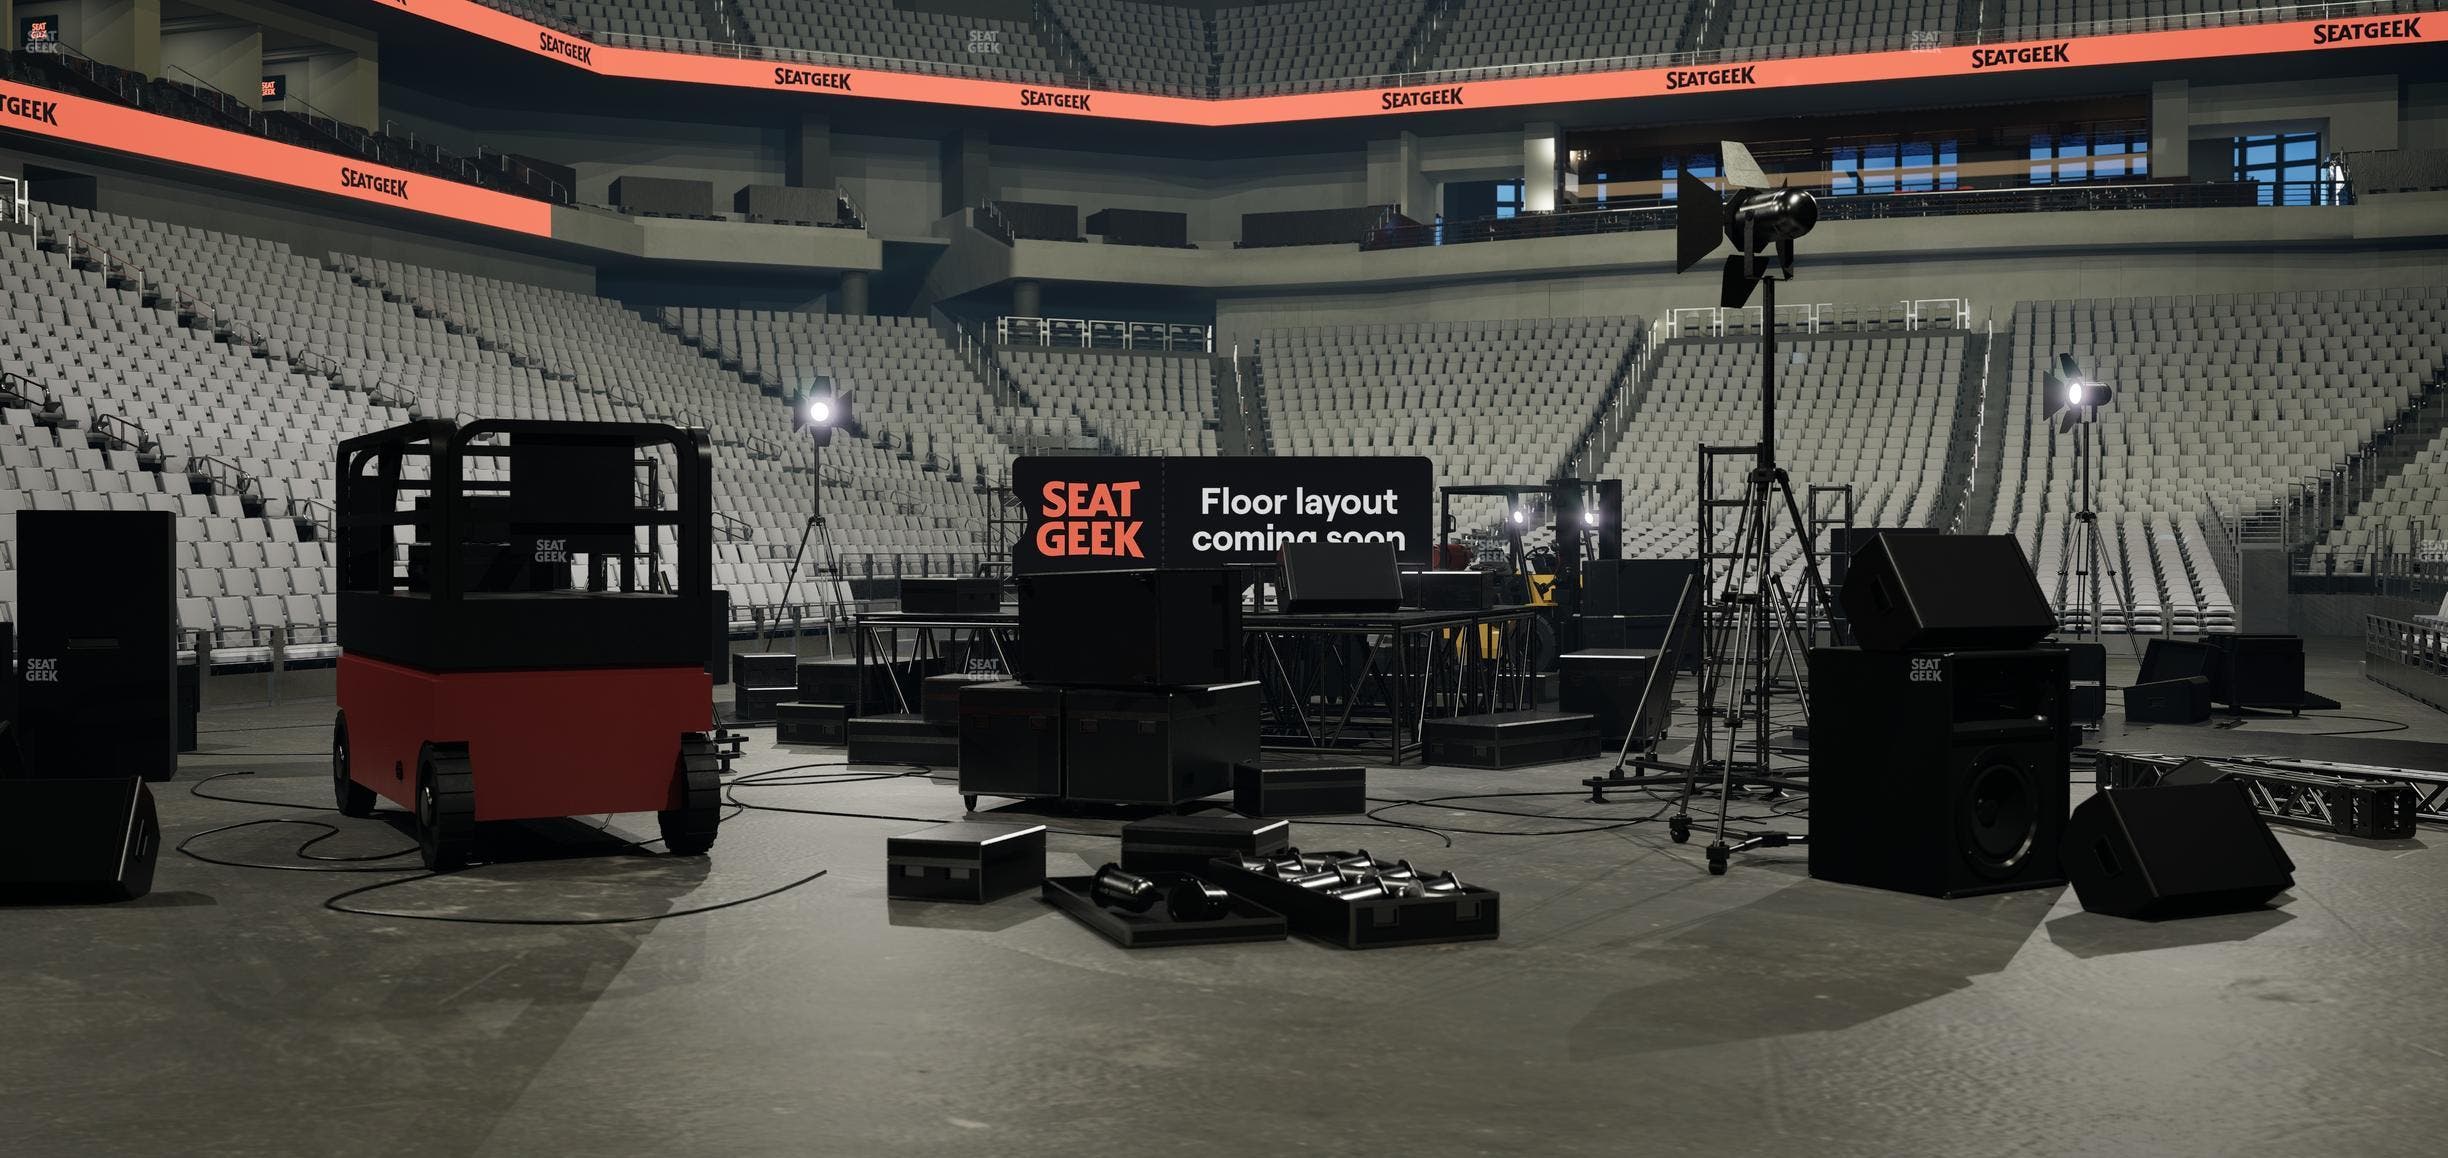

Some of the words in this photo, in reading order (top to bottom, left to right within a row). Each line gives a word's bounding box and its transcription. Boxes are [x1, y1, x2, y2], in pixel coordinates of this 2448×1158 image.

[2313, 17, 2422, 45] SEATGEEK
[539, 32, 592, 66] SEATGEEK
[1971, 43, 2070, 69] SEATGEEK
[774, 67, 852, 92] SEATGEEK
[1666, 66, 1756, 91] SEATGEEK
[1020, 88, 1091, 112] SEATGEEK
[1381, 87, 1464, 111] SEATGEEK
[341, 167, 409, 201] SEATGEEK
[1042, 480, 1141, 518] SEAT
[1202, 486, 1288, 515] Floor
[1296, 486, 1398, 522] layout
[1036, 521, 1144, 558] GEEK
[1327, 530, 1405, 551] soon
